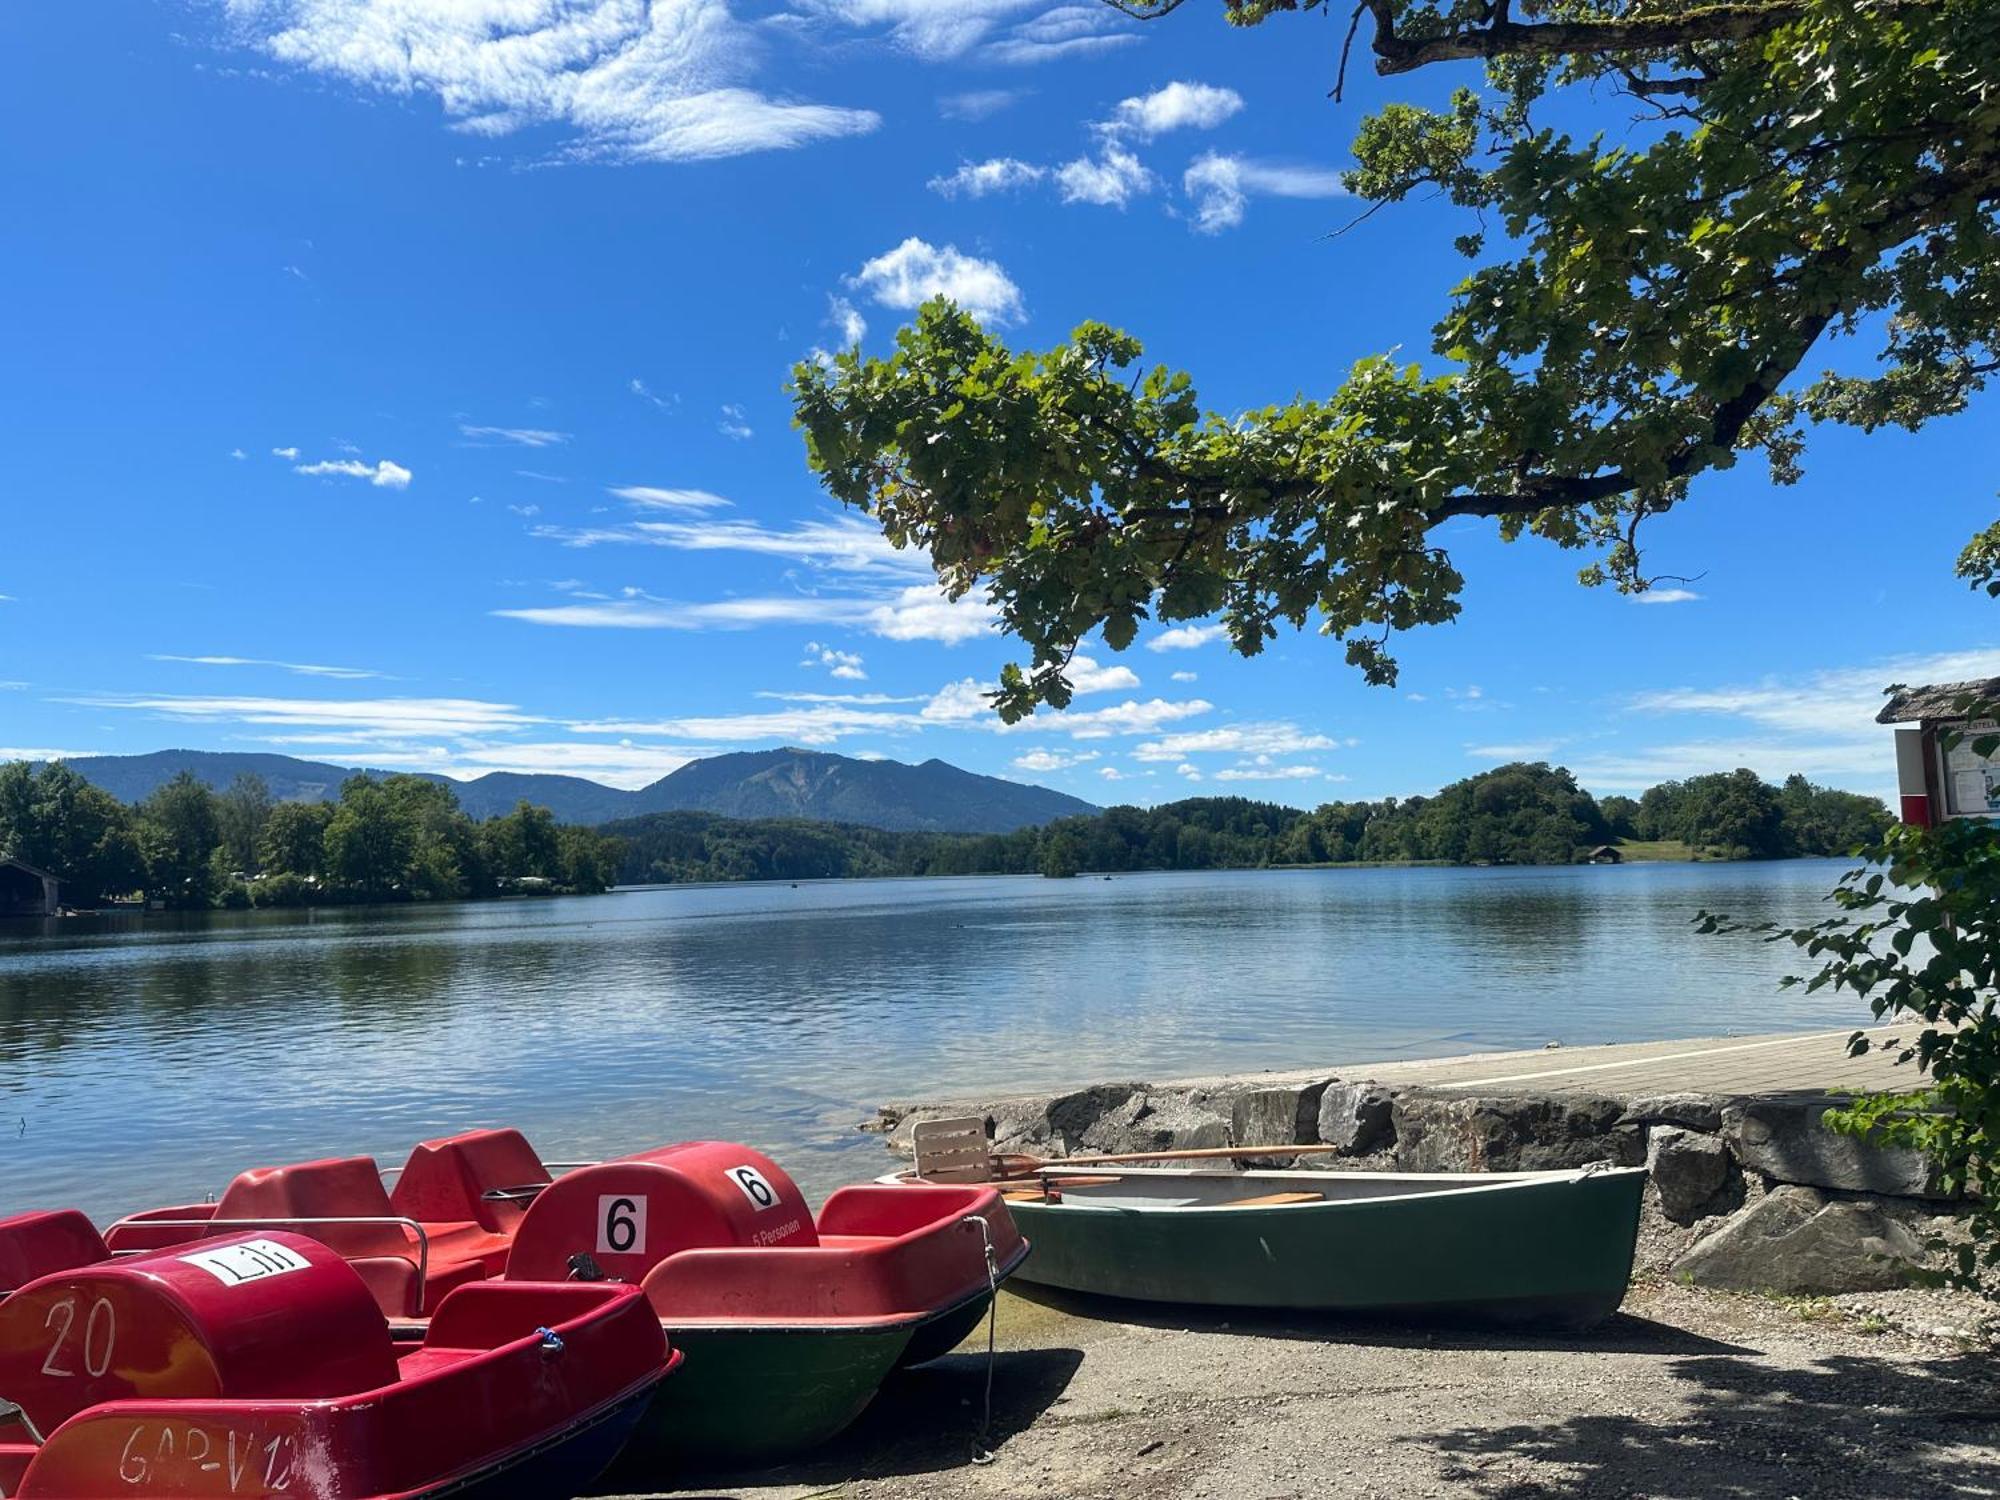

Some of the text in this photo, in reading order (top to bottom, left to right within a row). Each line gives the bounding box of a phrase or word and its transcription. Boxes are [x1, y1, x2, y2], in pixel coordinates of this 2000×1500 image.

[736, 1169, 772, 1206] 6
[607, 1198, 636, 1251] 6
[752, 1220, 800, 1248] 5 Personen
[208, 1245, 295, 1281] Lili
[41, 1298, 115, 1377] 20
